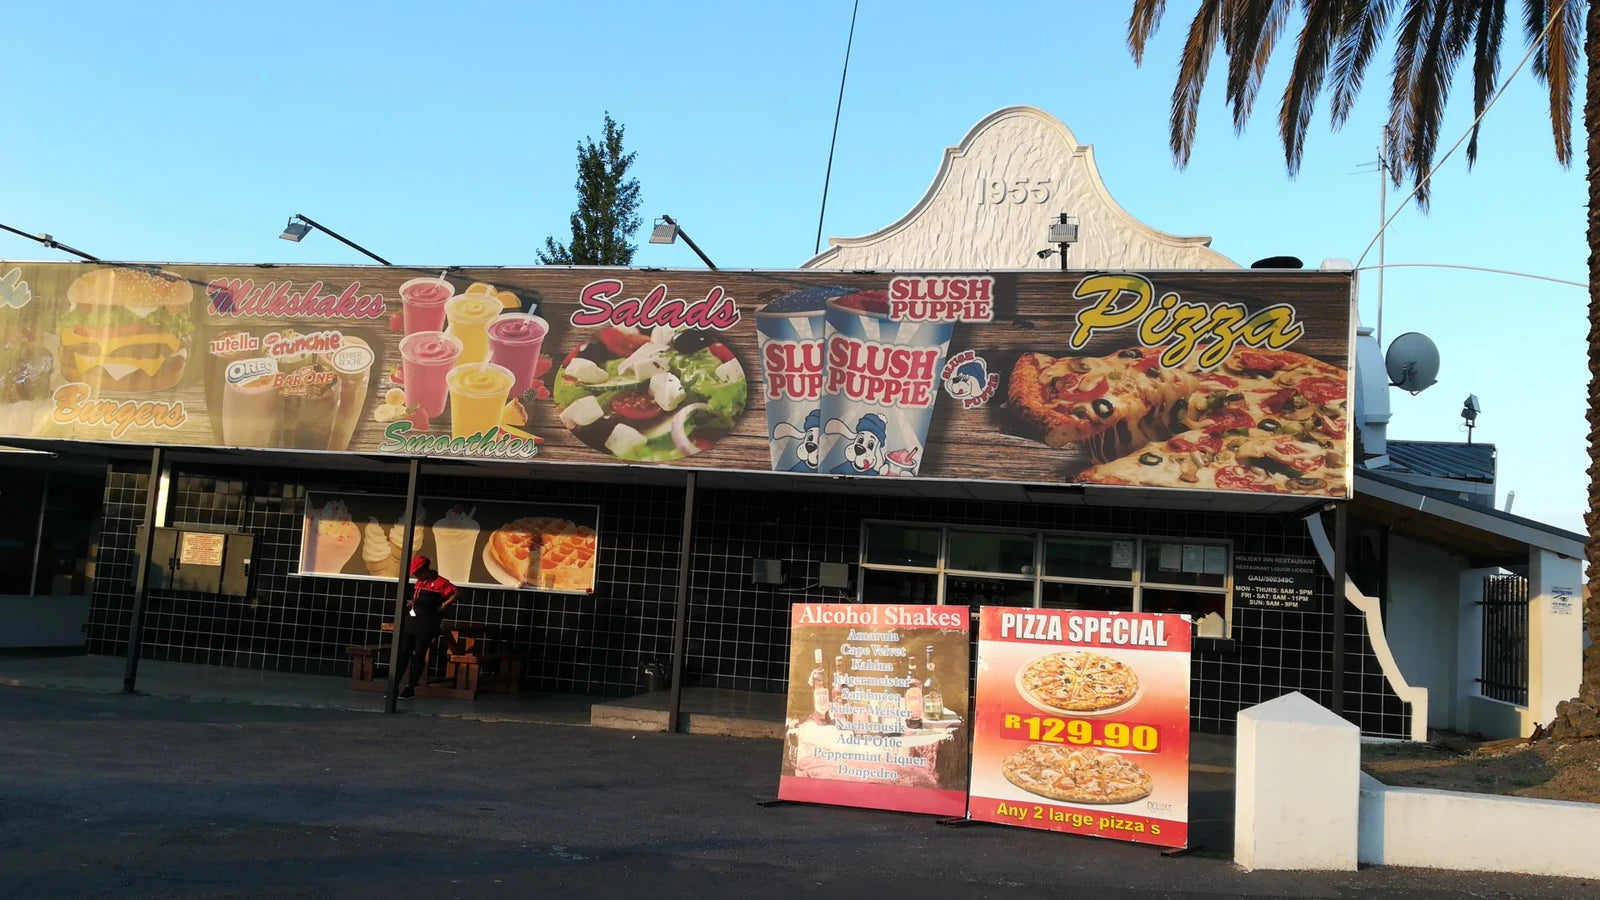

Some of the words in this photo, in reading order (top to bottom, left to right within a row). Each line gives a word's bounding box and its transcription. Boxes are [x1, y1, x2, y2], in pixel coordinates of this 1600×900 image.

[977, 177, 1051, 205] 1955
[207, 278, 387, 318] Milkshakes
[890, 278, 991, 300] SLUSH
[571, 279, 741, 330] Salads
[1069, 273, 1304, 370] Pizza
[210, 333, 259, 352] nutella
[765, 342, 824, 373] SLU
[828, 337, 938, 380] SLUSH
[227, 361, 275, 383] OREO
[767, 373, 823, 398] PUP
[52, 383, 187, 439] Burgers
[379, 420, 539, 459] Smoothies
[1275, 557, 1316, 565] RESTAURANT
[799, 605, 879, 625] Alcohol
[884, 607, 962, 627] Shakes
[847, 628, 900, 641] Amarula
[1001, 613, 1062, 641] PIZZA
[1068, 616, 1168, 647] SPECIAL
[840, 643, 870, 658] Cape
[870, 644, 907, 657] Velvet
[851, 658, 894, 672] Kahlua
[836, 734, 861, 746] Add
[813, 747, 886, 764] Peppermint
[886, 752, 926, 767] Liquer
[837, 764, 898, 780] Donpedro
[996, 802, 1028, 820] Any
[1033, 806, 1043, 819] 2
[1049, 807, 1094, 827] large
